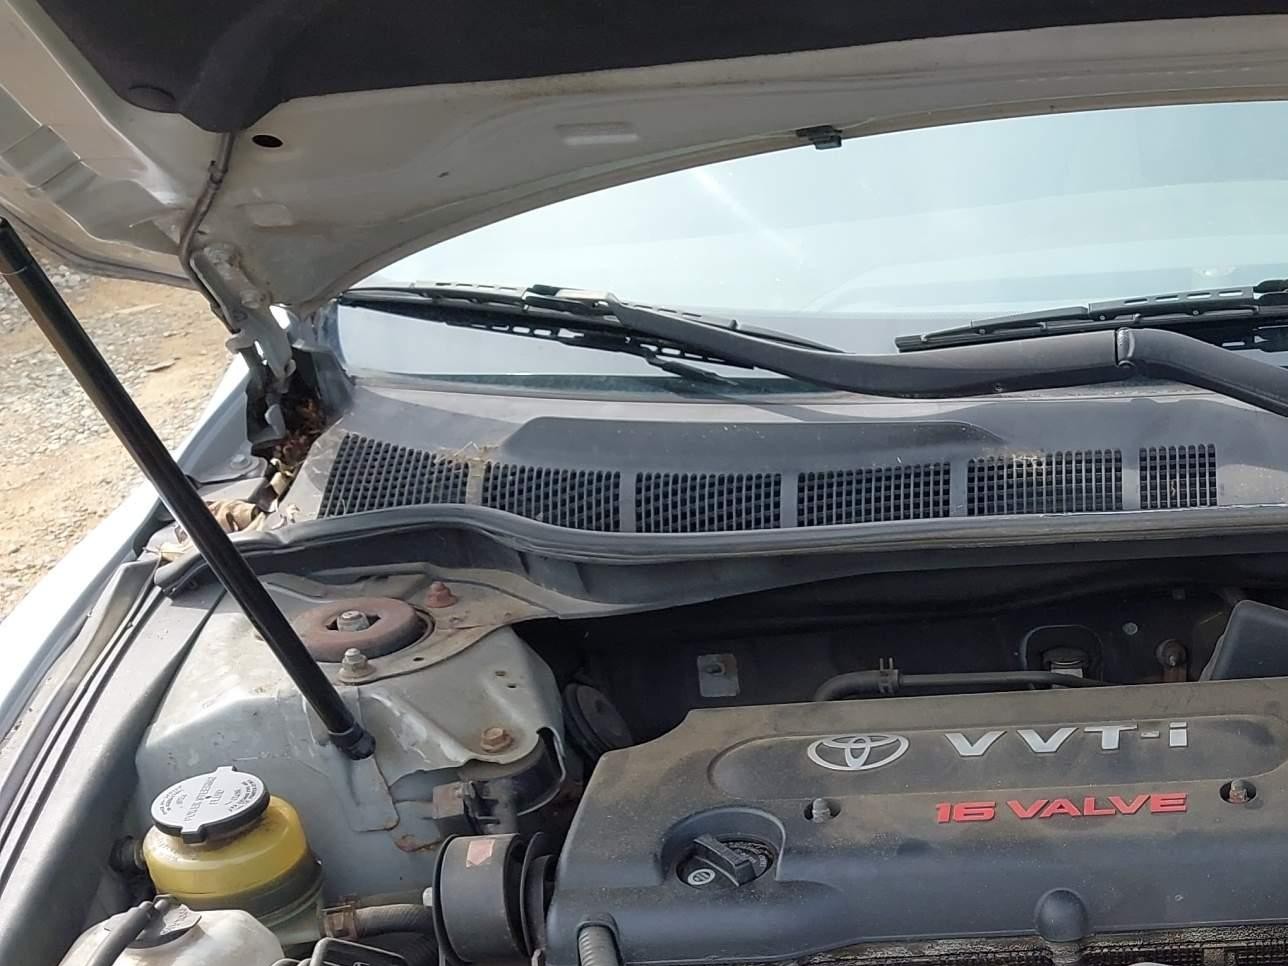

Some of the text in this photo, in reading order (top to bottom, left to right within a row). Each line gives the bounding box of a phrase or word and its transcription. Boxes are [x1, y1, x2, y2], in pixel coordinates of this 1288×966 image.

[944, 721, 1188, 757] VVT-i
[935, 793, 1188, 824] 16 VALVE
